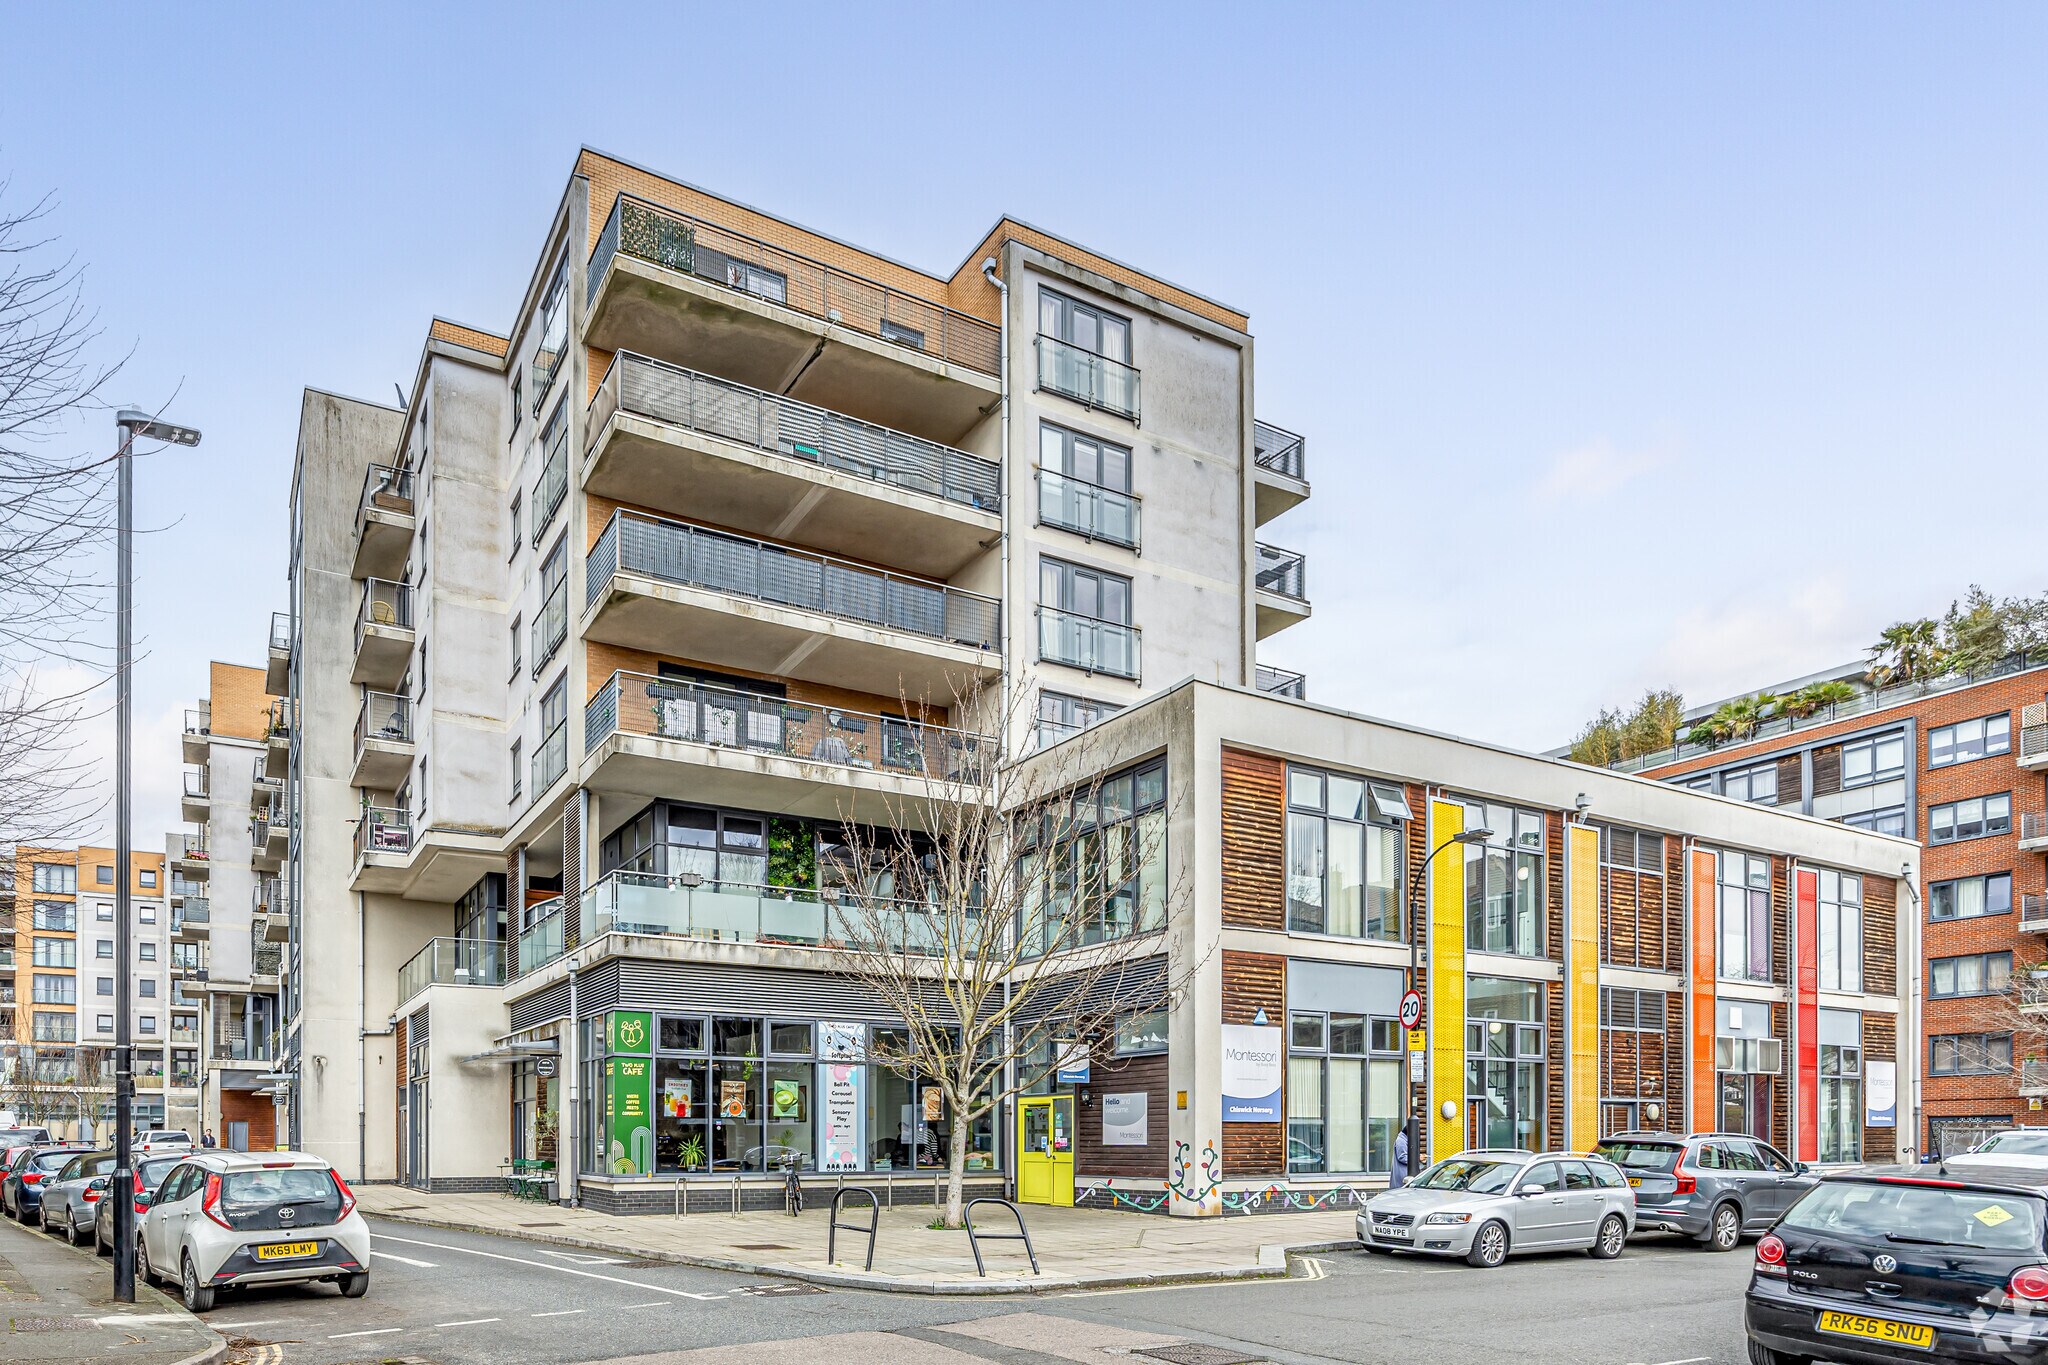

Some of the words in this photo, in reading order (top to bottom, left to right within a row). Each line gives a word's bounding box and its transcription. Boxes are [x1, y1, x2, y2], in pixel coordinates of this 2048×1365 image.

[1402, 1001, 1419, 1018] 20
[1226, 1047, 1277, 1062] Montessori
[622, 1068, 643, 1076] CAFE
[1229, 1105, 1252, 1114] Chiswick
[1253, 1106, 1274, 1115] Nursery
[1374, 1226, 1392, 1235] NA08
[1392, 1228, 1406, 1237] YPE
[263, 1245, 291, 1257] MK69
[293, 1243, 313, 1254] LMY
[1793, 1270, 1818, 1280] POLO
[1829, 1312, 1879, 1335] RK56
[1884, 1322, 1924, 1342] SNU
